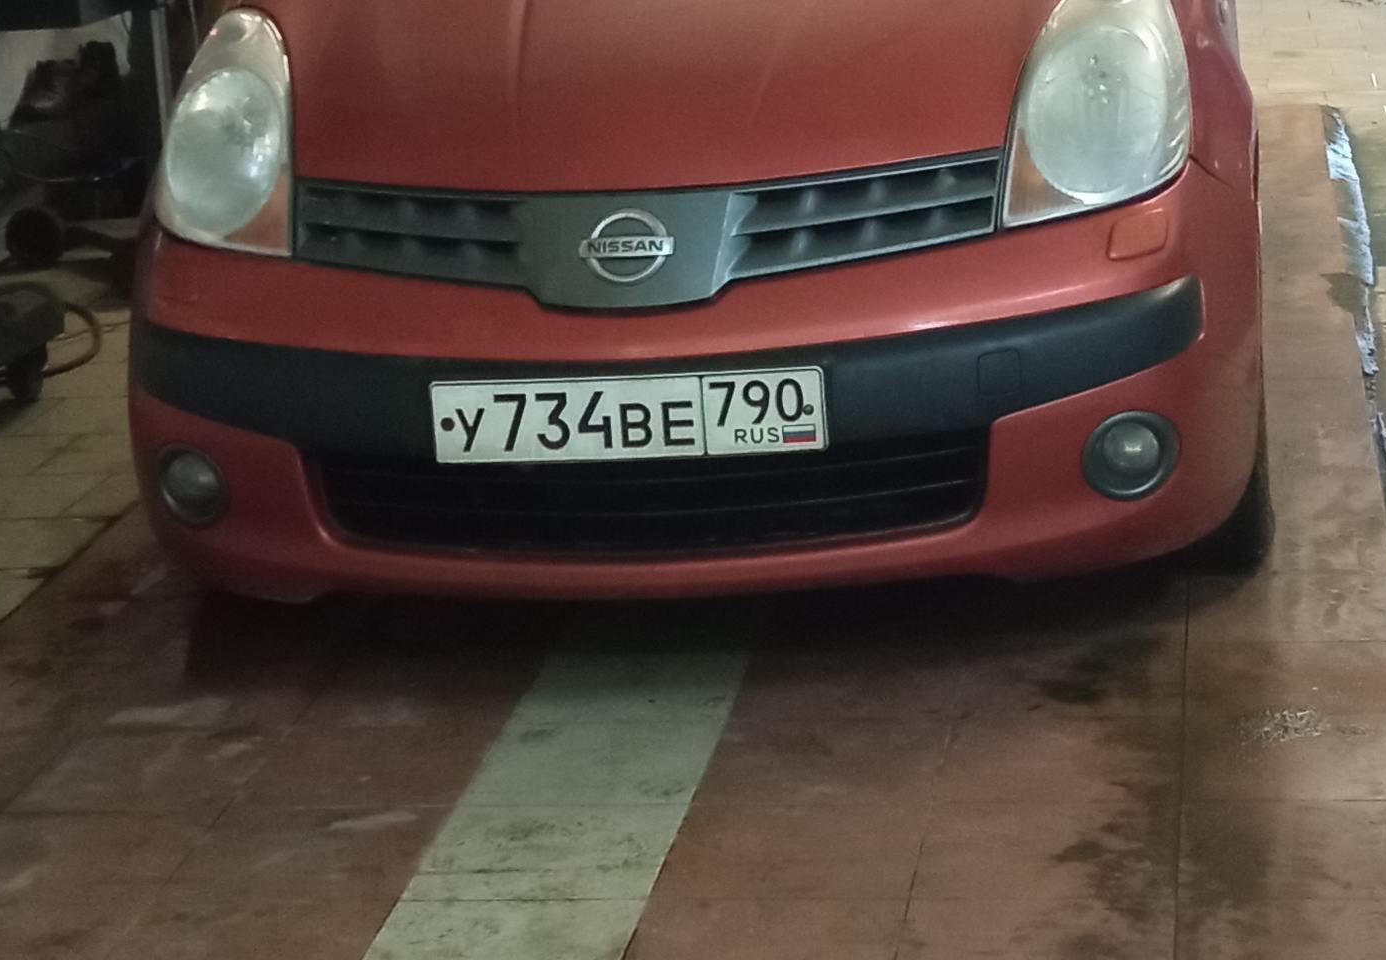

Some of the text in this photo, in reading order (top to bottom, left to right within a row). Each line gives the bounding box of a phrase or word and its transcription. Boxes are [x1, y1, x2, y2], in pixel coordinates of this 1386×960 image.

[587, 239, 663, 253] NISSAN
[708, 377, 805, 427] 790
[734, 426, 780, 444] RUS
